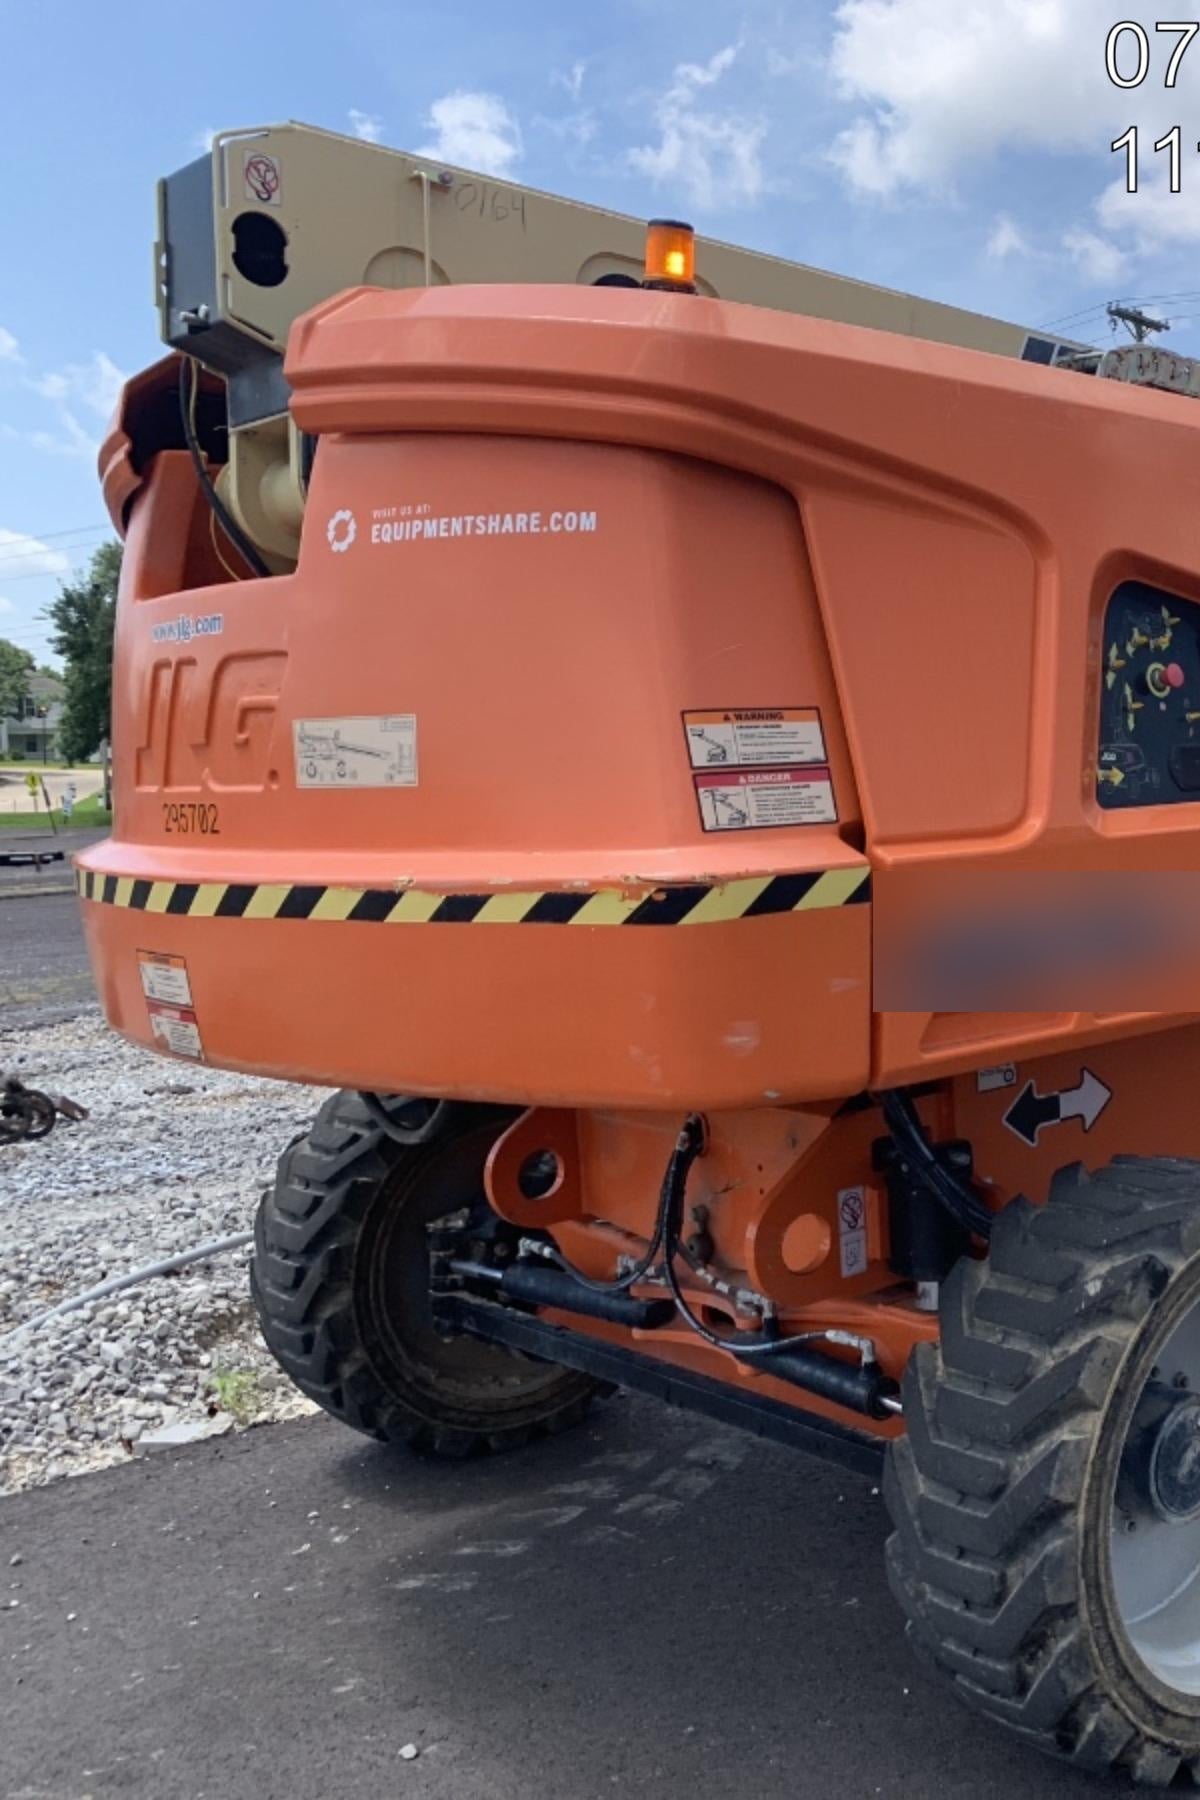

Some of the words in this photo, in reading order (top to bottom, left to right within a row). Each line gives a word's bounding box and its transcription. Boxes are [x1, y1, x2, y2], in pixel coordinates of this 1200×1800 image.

[370, 511, 598, 545] EQUIPMENTSHARE.COM
[733, 711, 785, 722] WARNING
[747, 773, 791, 784] DANGER
[162, 803, 221, 836] 295702
